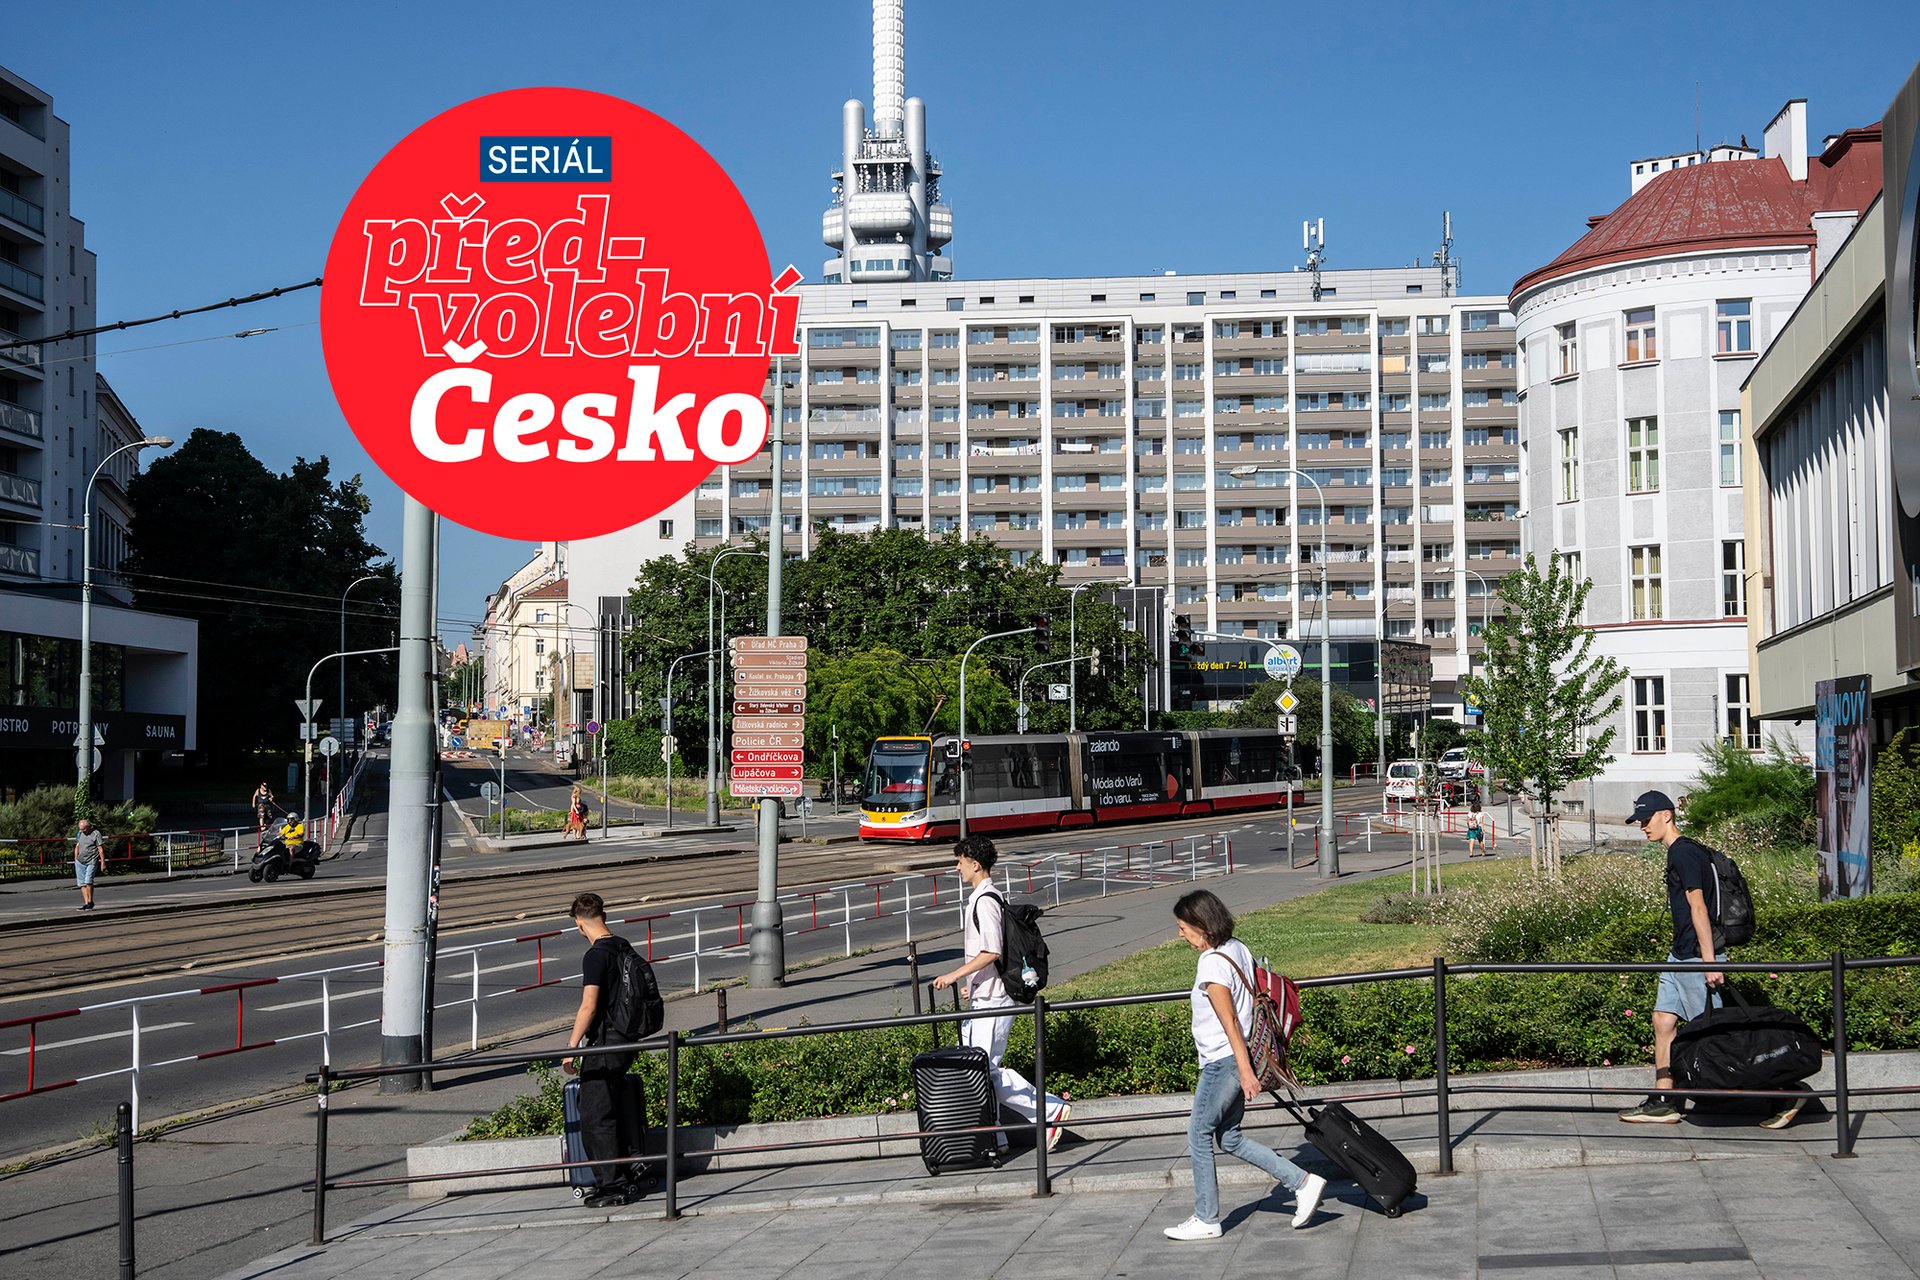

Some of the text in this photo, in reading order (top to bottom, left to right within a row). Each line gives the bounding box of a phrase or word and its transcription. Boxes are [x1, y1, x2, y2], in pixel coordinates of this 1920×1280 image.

[751, 638, 803, 648] Úřad MČ Praha 3
[1188, 660, 1209, 671] každý
[1210, 661, 1223, 669] den
[1225, 661, 1230, 669] 7
[1238, 661, 1247, 669] 21
[748, 686, 791, 696] Žižkovská věž
[1817, 679, 1866, 727] SAUNOVÝ
[52, 720, 109, 736] POTRNY
[146, 725, 175, 738] SAUNA
[736, 720, 788, 729] Žižkovská radnice
[735, 734, 782, 745] Policie ČR
[1090, 739, 1120, 753] zalando
[747, 752, 799, 761] Ondříčkova
[733, 768, 776, 779] Lupáčova
[1092, 773, 1142, 789] Móda do Varů
[1103, 792, 1113, 804] do
